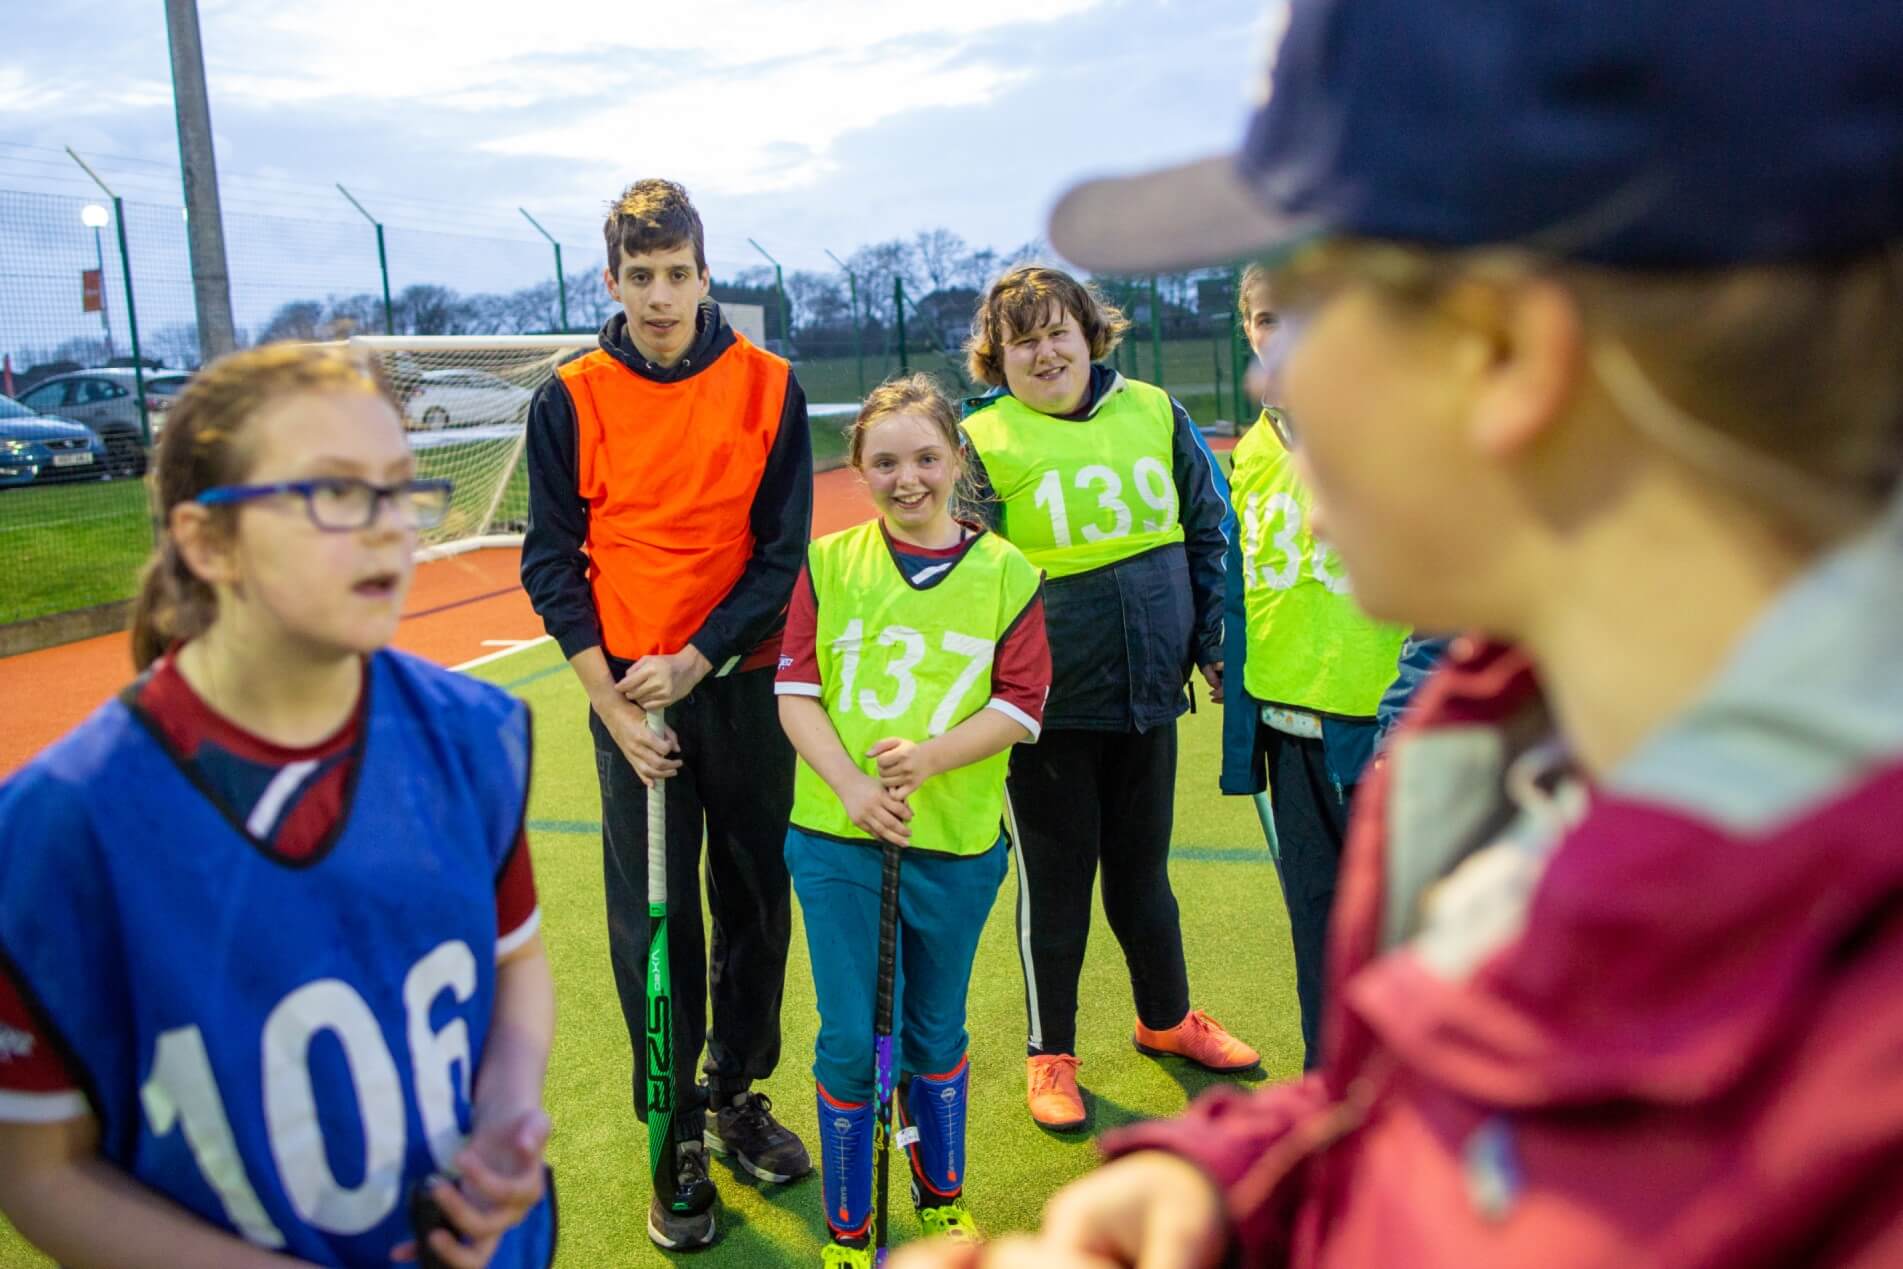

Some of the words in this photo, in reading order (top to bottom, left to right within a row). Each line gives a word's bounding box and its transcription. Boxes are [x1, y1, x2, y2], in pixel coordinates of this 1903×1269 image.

[1034, 457, 1173, 548] 139
[832, 619, 996, 737] 137
[140, 939, 476, 1247] 106
